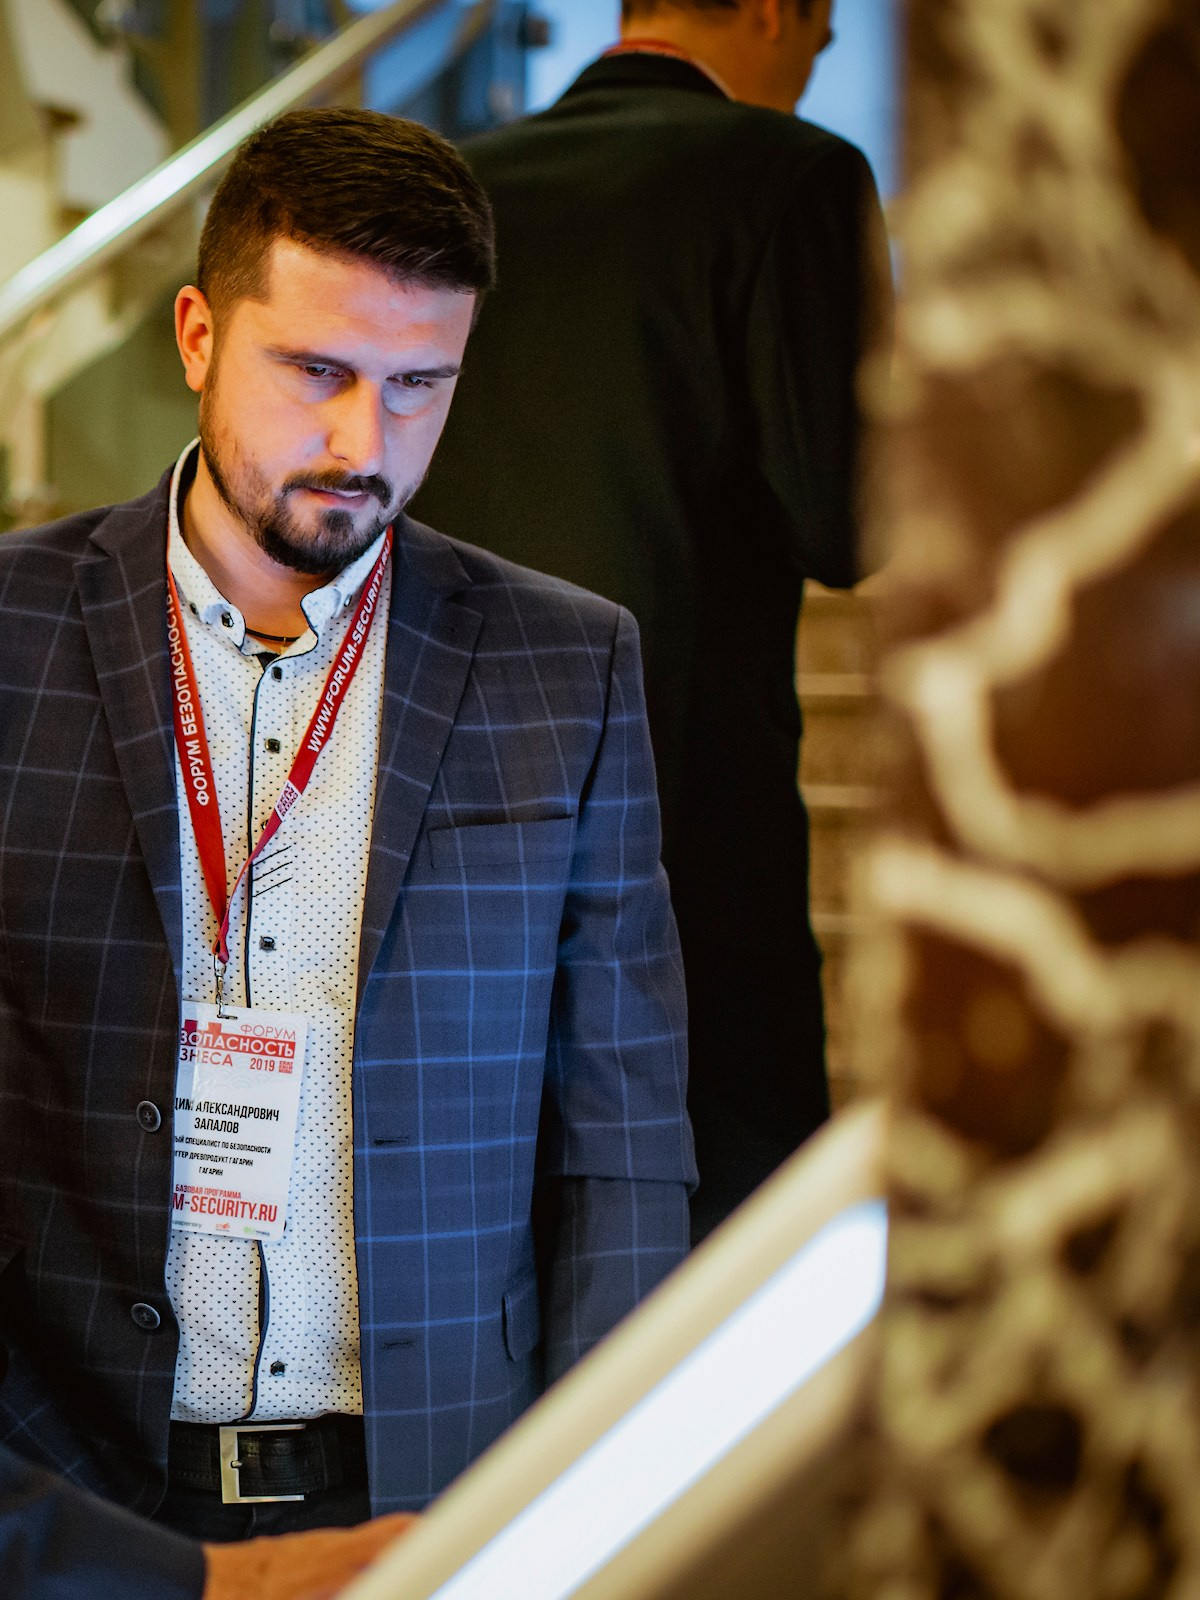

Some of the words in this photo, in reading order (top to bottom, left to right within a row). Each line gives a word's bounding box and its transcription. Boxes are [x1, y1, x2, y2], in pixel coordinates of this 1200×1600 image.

[190, 742, 209, 806] ФОРУМ
[240, 1024, 296, 1040] ФОРУМ
[250, 1058, 275, 1072] 2019
[196, 1101, 279, 1121] АЛЕКСАНДРОВИЧ
[194, 1118, 239, 1133] ЗАПАЛОВ
[185, 1137, 220, 1147] СПЕЦИАЛИСТ
[230, 1143, 271, 1154] БЕЗОПАСНОСТИ
[189, 1152, 228, 1162] ДРЕВПРОДУКТ
[175, 1184, 203, 1195] БАЗОВАЯ
[204, 1187, 241, 1199] ПРОГРАММА
[173, 1193, 277, 1222] M-SECURITY.RU
